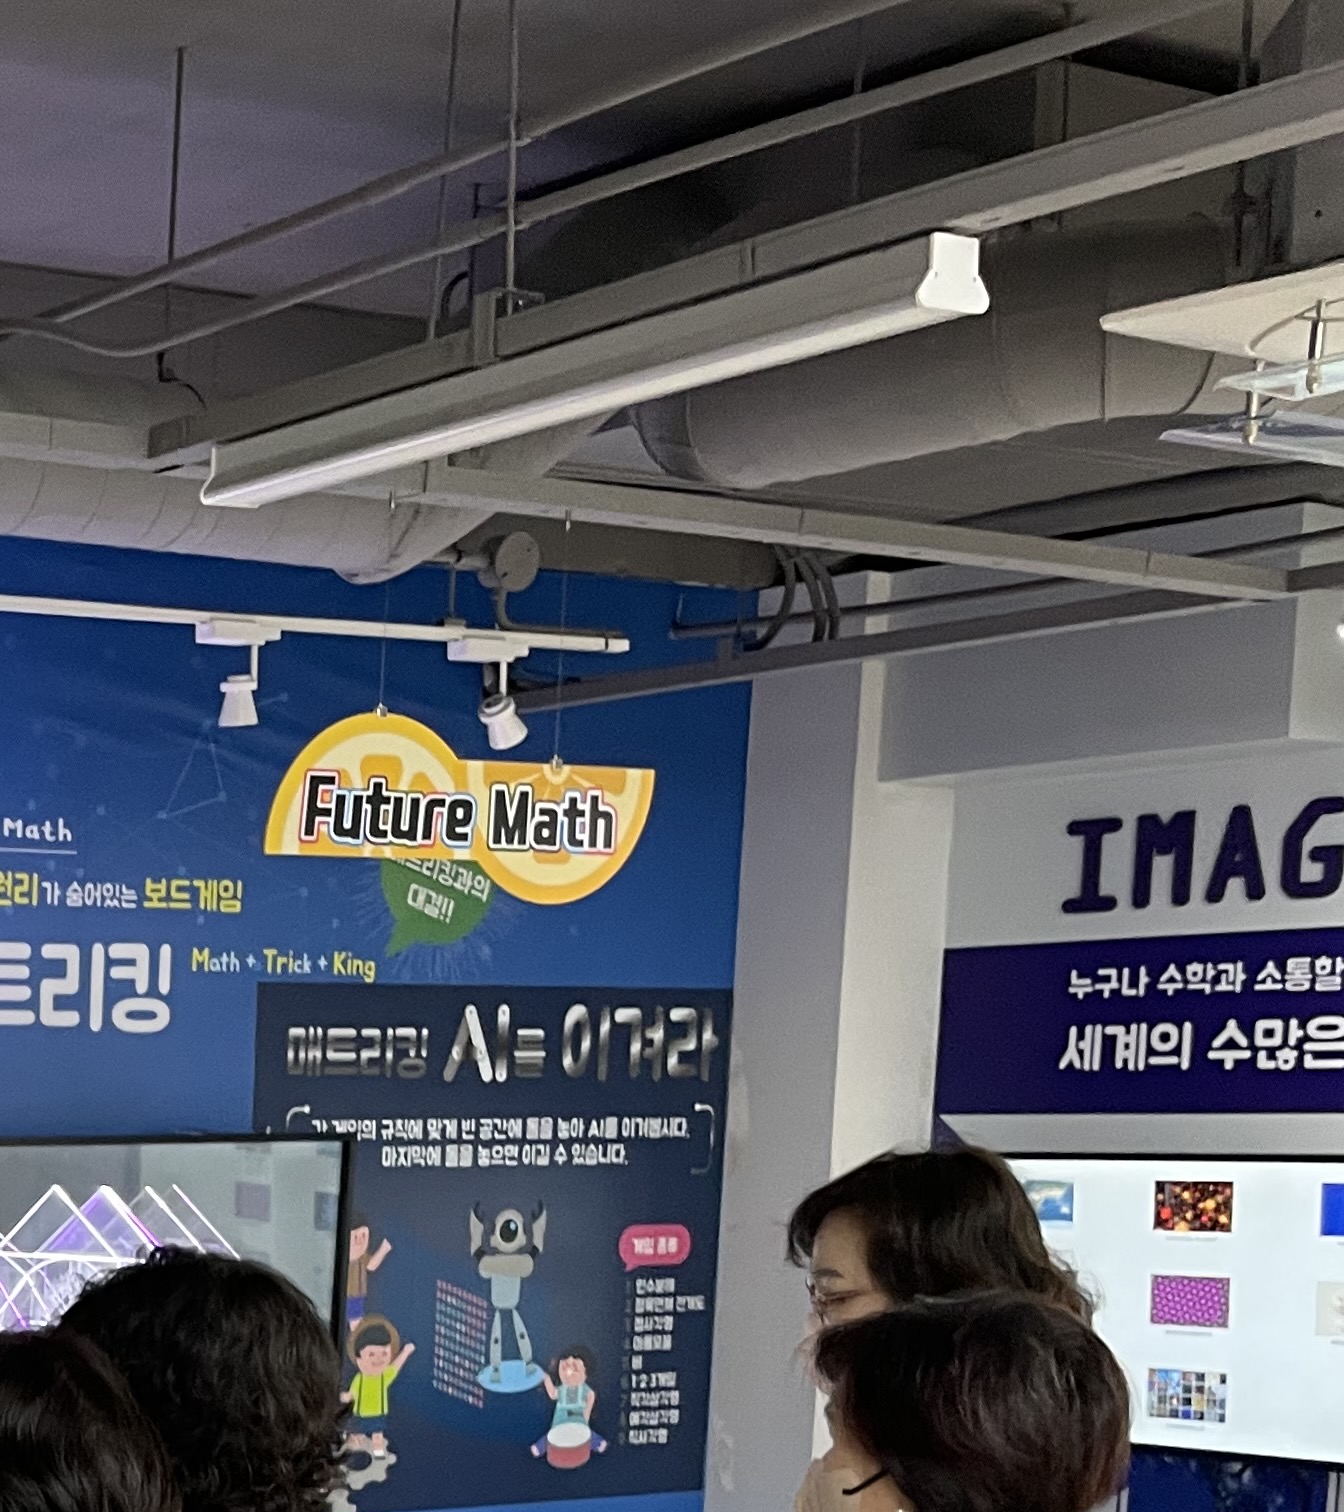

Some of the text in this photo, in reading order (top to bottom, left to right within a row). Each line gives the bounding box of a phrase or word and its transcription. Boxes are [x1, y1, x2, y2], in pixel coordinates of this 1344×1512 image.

[3, 818, 73, 842] Math
[300, 771, 617, 853] Future Math
[143, 878, 243, 913] 보드게임
[192, 947, 240, 973] Math
[263, 948, 312, 975] Trick
[333, 950, 376, 984] King
[1067, 964, 1151, 1000] 누구나
[1156, 960, 1247, 996] 수학과
[287, 1026, 429, 1079] 매트리킹
[561, 1003, 719, 1083] 이겨라
[1058, 1021, 1193, 1072] 세계의
[381, 1118, 423, 1142] 규칙에
[381, 1144, 442, 1168] 마지막에
